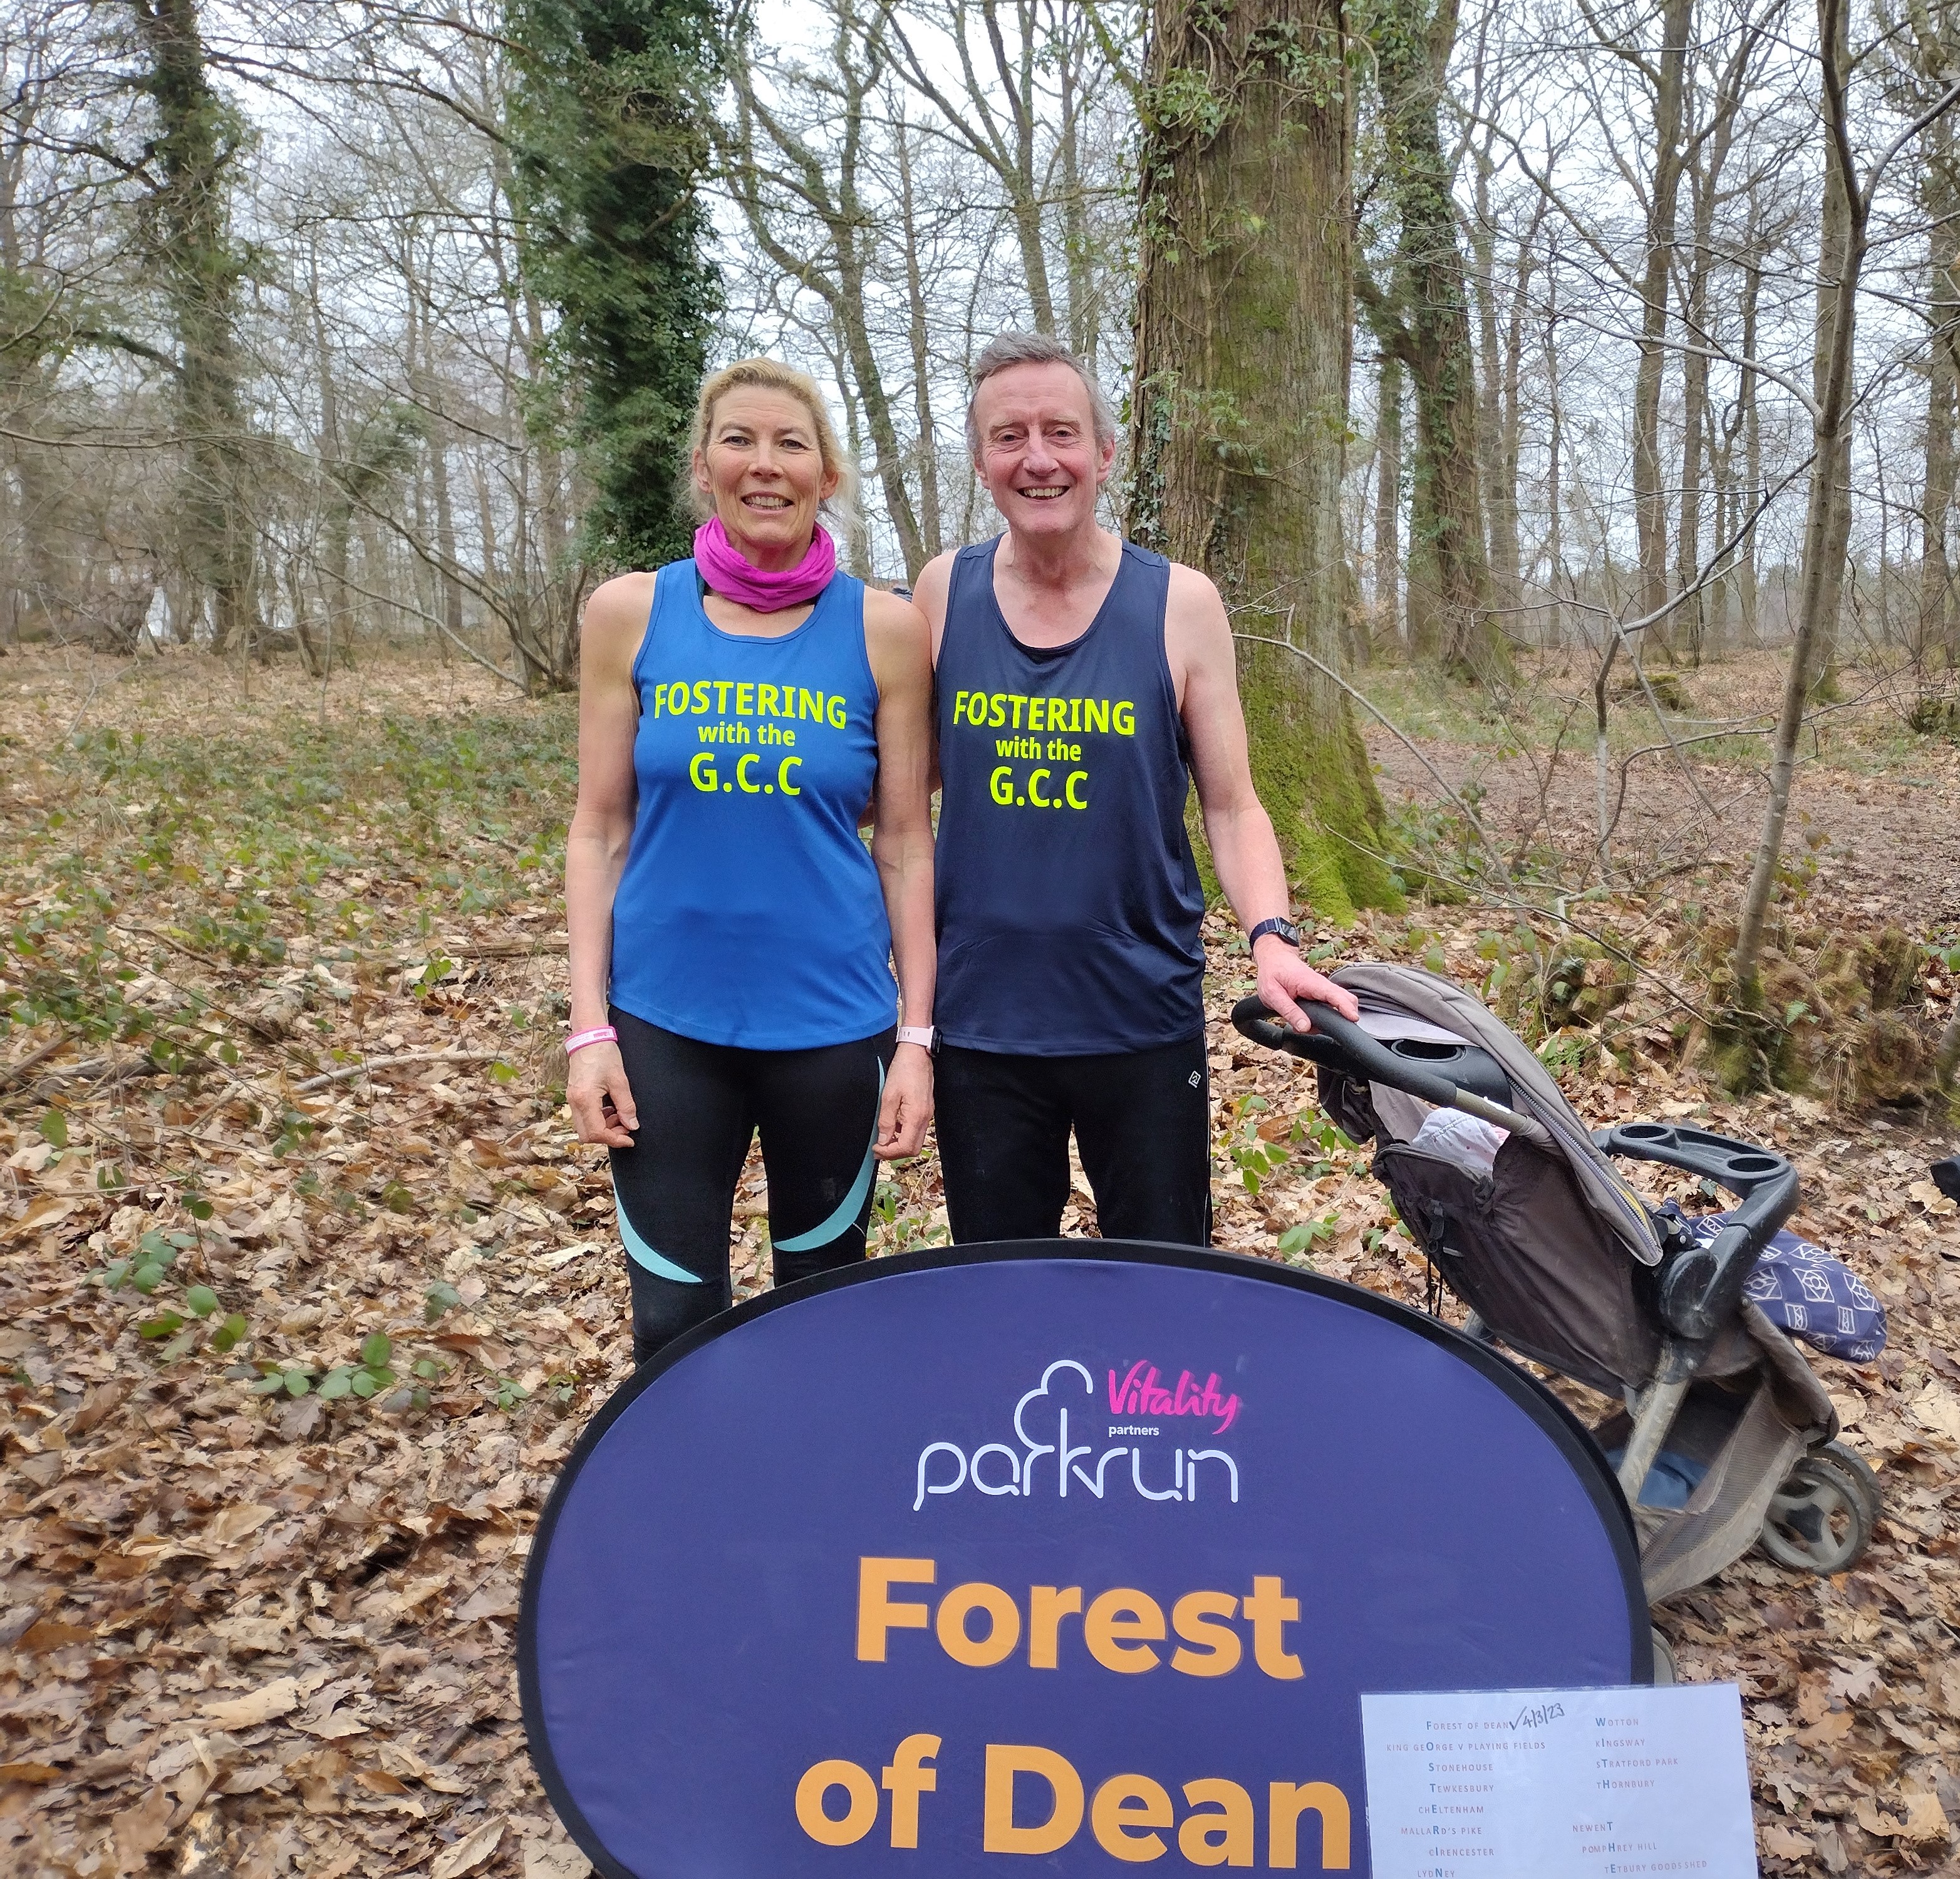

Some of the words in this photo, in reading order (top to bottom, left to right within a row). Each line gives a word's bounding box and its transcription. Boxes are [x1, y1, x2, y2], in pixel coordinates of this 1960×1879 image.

[655, 680, 846, 730] FOSTERING
[953, 691, 1135, 735] FOSTERING
[698, 721, 750, 743] with
[757, 723, 796, 746] the
[995, 736, 1041, 760] with
[1047, 738, 1082, 762] the
[689, 752, 803, 795] G.C.C
[990, 766, 1089, 810] G.C.C
[1108, 1360, 1239, 1435] Vitality
[1108, 1425, 1160, 1437] partners
[913, 1408, 1238, 1511] parkrun
[856, 1557, 1305, 1680] Forest
[1523, 1703, 1565, 1729] 4/3/23
[1595, 1717, 1639, 1727] WOTTON
[1426, 1721, 1463, 1731] FOREST
[1468, 1722, 1480, 1730] OF
[1484, 1721, 1509, 1729] DEAN
[1386, 1744, 1409, 1752] KING
[1413, 1742, 1454, 1751] GEORGE
[1468, 1742, 1509, 1751] PLAYING
[1513, 1742, 1546, 1750] FIELDS
[1595, 1738, 1646, 1747] KINGSWAY
[1429, 1763, 1494, 1772] STONEHOUSE
[1596, 1759, 1651, 1769] STRATFORD
[1656, 1758, 1679, 1766] PARK
[1429, 1783, 1495, 1793] TEWKESBURY
[1596, 1779, 1655, 1789] THORNBURY
[795, 1734, 942, 1848] of
[983, 1744, 1351, 1870] Dean
[1418, 1804, 1485, 1814] CHELTENHAM
[1461, 1827, 1483, 1835] PIKE
[1572, 1821, 1614, 1833] NEWENT
[1429, 1846, 1495, 1856] CIRENCESTER
[1582, 1843, 1634, 1854] POMPHREY
[1637, 1842, 1657, 1851] HILL
[1417, 1868, 1455, 1878] LYDNEY
[1604, 1863, 1647, 1874] TETBURY
